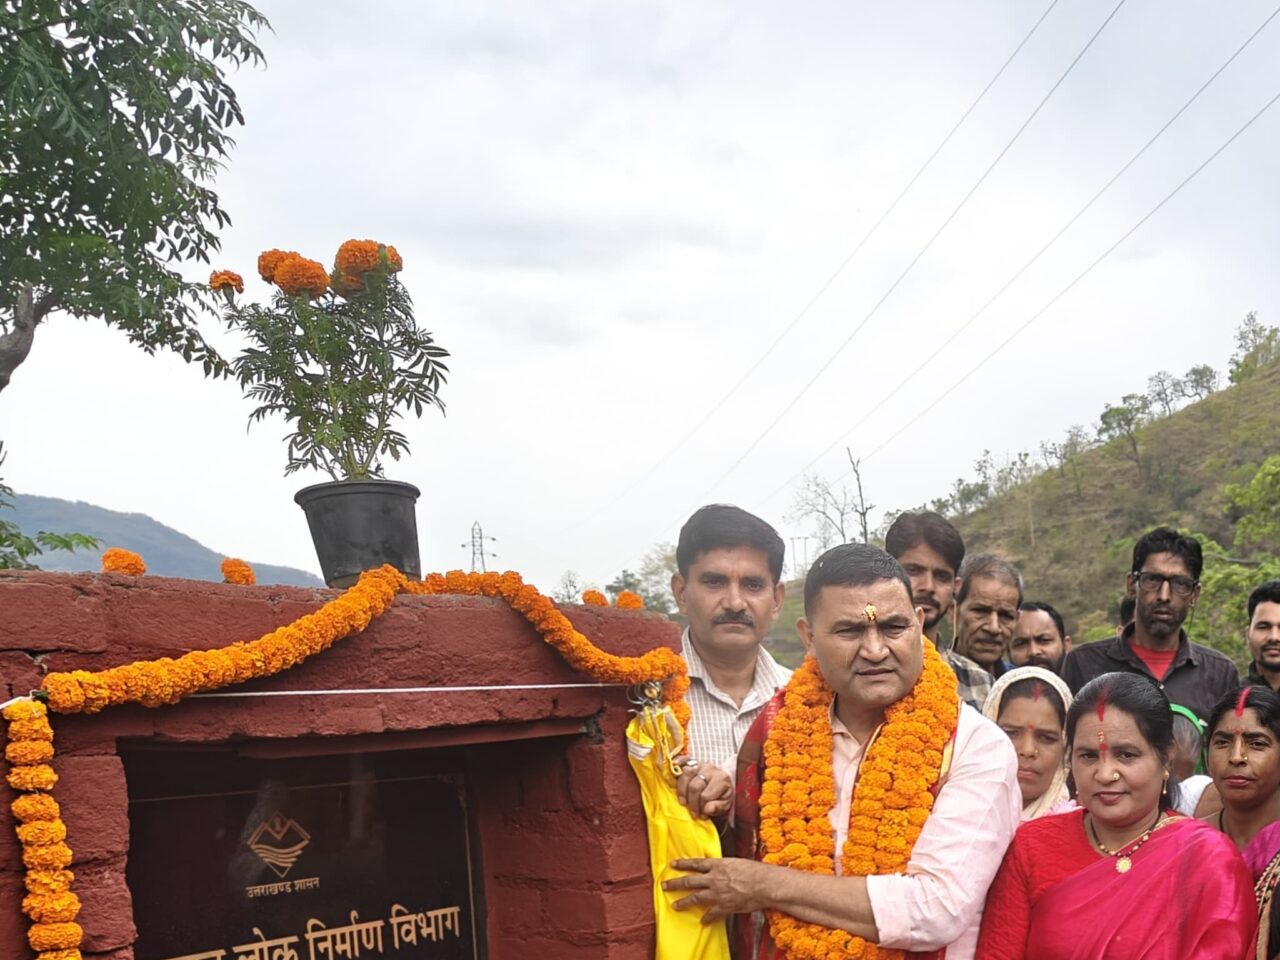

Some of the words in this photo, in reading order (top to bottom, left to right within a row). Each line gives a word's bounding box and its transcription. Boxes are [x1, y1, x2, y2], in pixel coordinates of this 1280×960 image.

[246, 881, 292, 898] उत्तराखण्ड
[294, 876, 320, 892] शासन
[389, 903, 461, 951] विभाग
